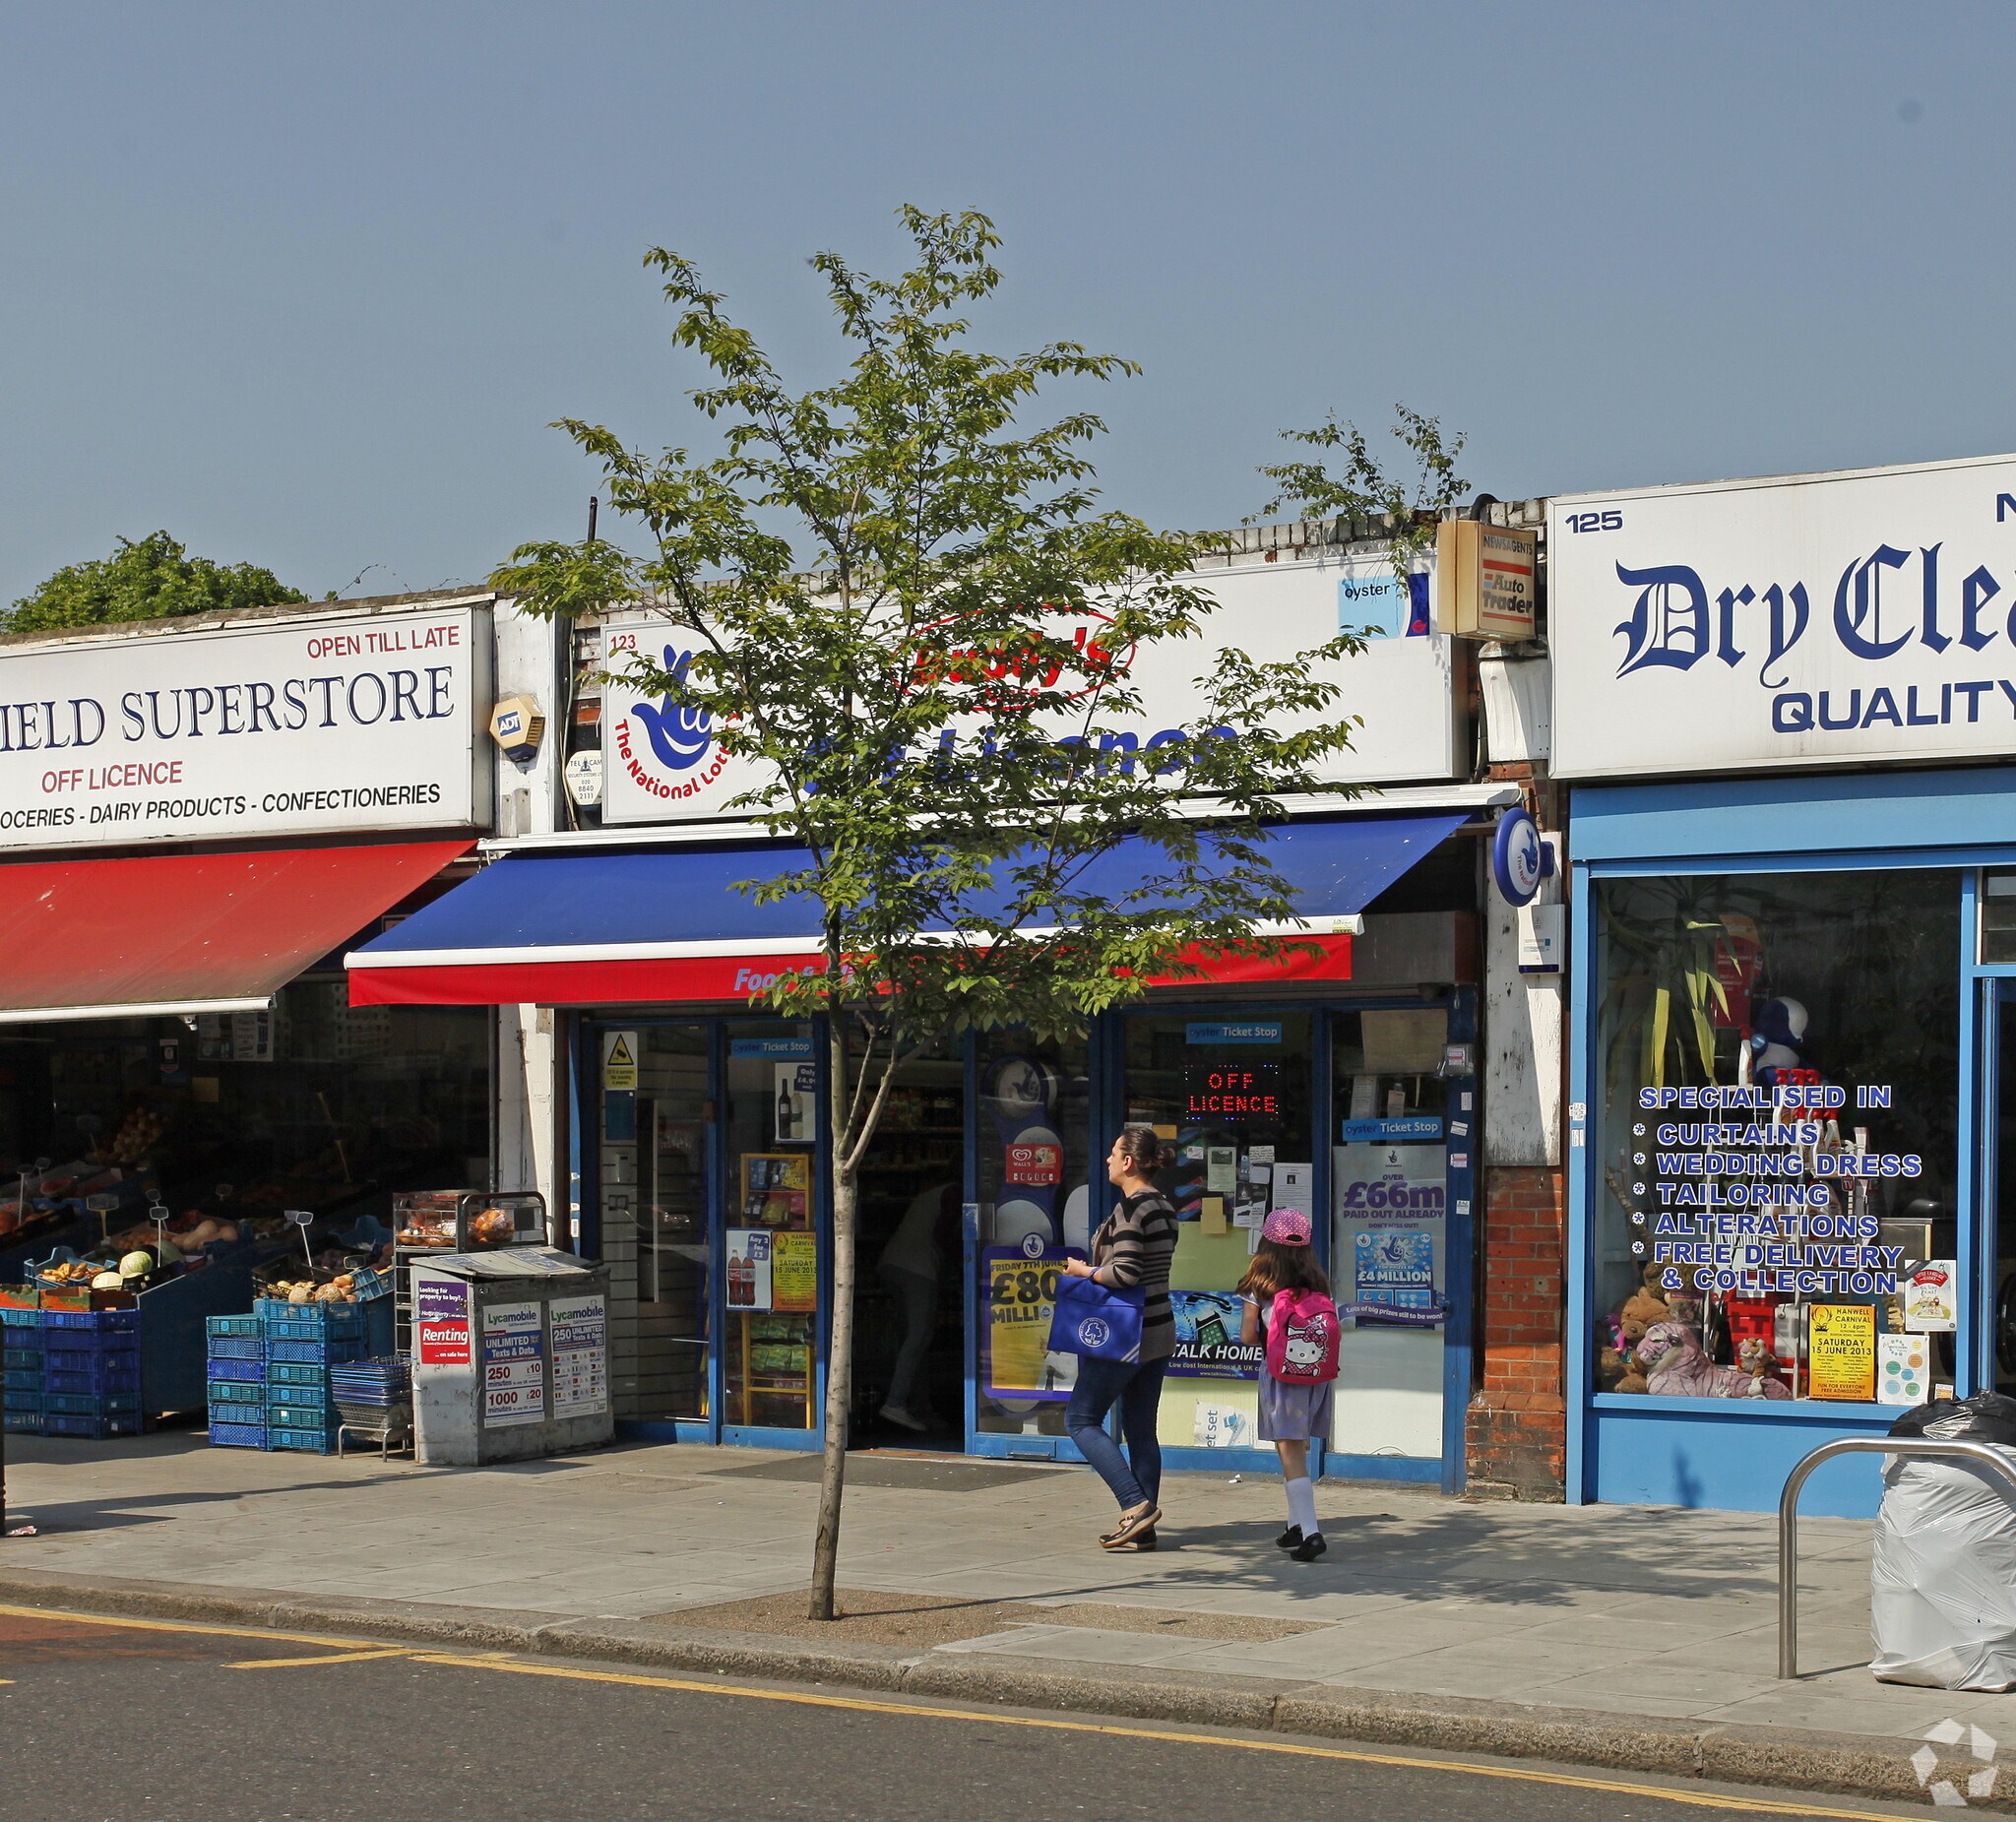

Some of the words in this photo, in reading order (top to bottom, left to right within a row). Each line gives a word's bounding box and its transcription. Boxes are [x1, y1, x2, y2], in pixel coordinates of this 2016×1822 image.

[1565, 510, 1623, 534] 125
[1483, 534, 1533, 555] NEWSAGENTS
[1345, 583, 1392, 599] oyster
[1492, 574, 1525, 594] Auto
[1482, 591, 1534, 614] Trader
[1612, 558, 1809, 689] Dry
[1833, 540, 2016, 660] Cle
[307, 635, 361, 660] OPEN
[365, 631, 407, 654] TILL
[411, 625, 461, 649] LATE
[610, 634, 637, 650] 123
[121, 665, 455, 742] SUPERSTORE
[498, 717, 521, 736] ADT
[615, 719, 632, 760] The
[627, 758, 702, 800] National
[41, 769, 85, 794] OFF
[89, 761, 183, 790] LICENCE
[90, 801, 143, 824] DAIRY
[146, 795, 246, 820] PRODUCTS
[262, 783, 441, 813] CONFECTIONERIES
[1223, 1027, 1253, 1037] Ticket
[1255, 1027, 1278, 1038] Stop
[763, 1041, 788, 1052] Ticket
[789, 1041, 810, 1052] Stop
[1208, 1073, 1254, 1090] OFF
[1189, 1096, 1275, 1112] LICENCE
[1639, 1086, 1847, 1109] SPECIALISED
[1857, 1085, 1892, 1108] IN
[1347, 1124, 1377, 1136] oyster
[1380, 1122, 1412, 1133] Ticket
[1415, 1121, 1439, 1133] Stop
[1657, 1123, 1819, 1147] CURTAINS
[1657, 1153, 1804, 1176] WEDDING
[1816, 1154, 1923, 1177] DRESS
[1343, 1181, 1445, 1209] £66m
[1656, 1182, 1830, 1206] TAILORING
[1343, 1210, 1369, 1219] PAID
[1370, 1210, 1393, 1219] OUT
[1395, 1210, 1445, 1220] ALREADY
[1655, 1213, 1879, 1238] ALTERATIONS
[1655, 1241, 1732, 1264] FREE
[1744, 1244, 1906, 1269] DELIVERY
[991, 1262, 1022, 1272] FRIDAY
[1023, 1260, 1040, 1270] 7TH
[1357, 1271, 1375, 1282] £4
[1378, 1271, 1431, 1282] MILLION
[1661, 1267, 1684, 1290] &
[1693, 1268, 1897, 1294] COLLECTION
[990, 1270, 1058, 1305] £80
[488, 1310, 537, 1325] Lycamobile
[551, 1305, 603, 1323] Lycamobile
[1368, 1306, 1378, 1315] big
[422, 1328, 469, 1346] Renting
[554, 1329, 571, 1341] 250
[572, 1324, 603, 1335] UNLIMITED
[485, 1336, 530, 1349] UNLIMITED
[492, 1349, 510, 1357] Texts
[512, 1348, 518, 1356] &
[519, 1347, 535, 1355] Data
[1216, 1345, 1262, 1360] HOME
[488, 1366, 510, 1380] 250
[527, 1363, 540, 1374] £10
[488, 1379, 512, 1388] minutes
[488, 1392, 518, 1406] 1000
[527, 1389, 540, 1400] £20
[1208, 1410, 1219, 1431] set
